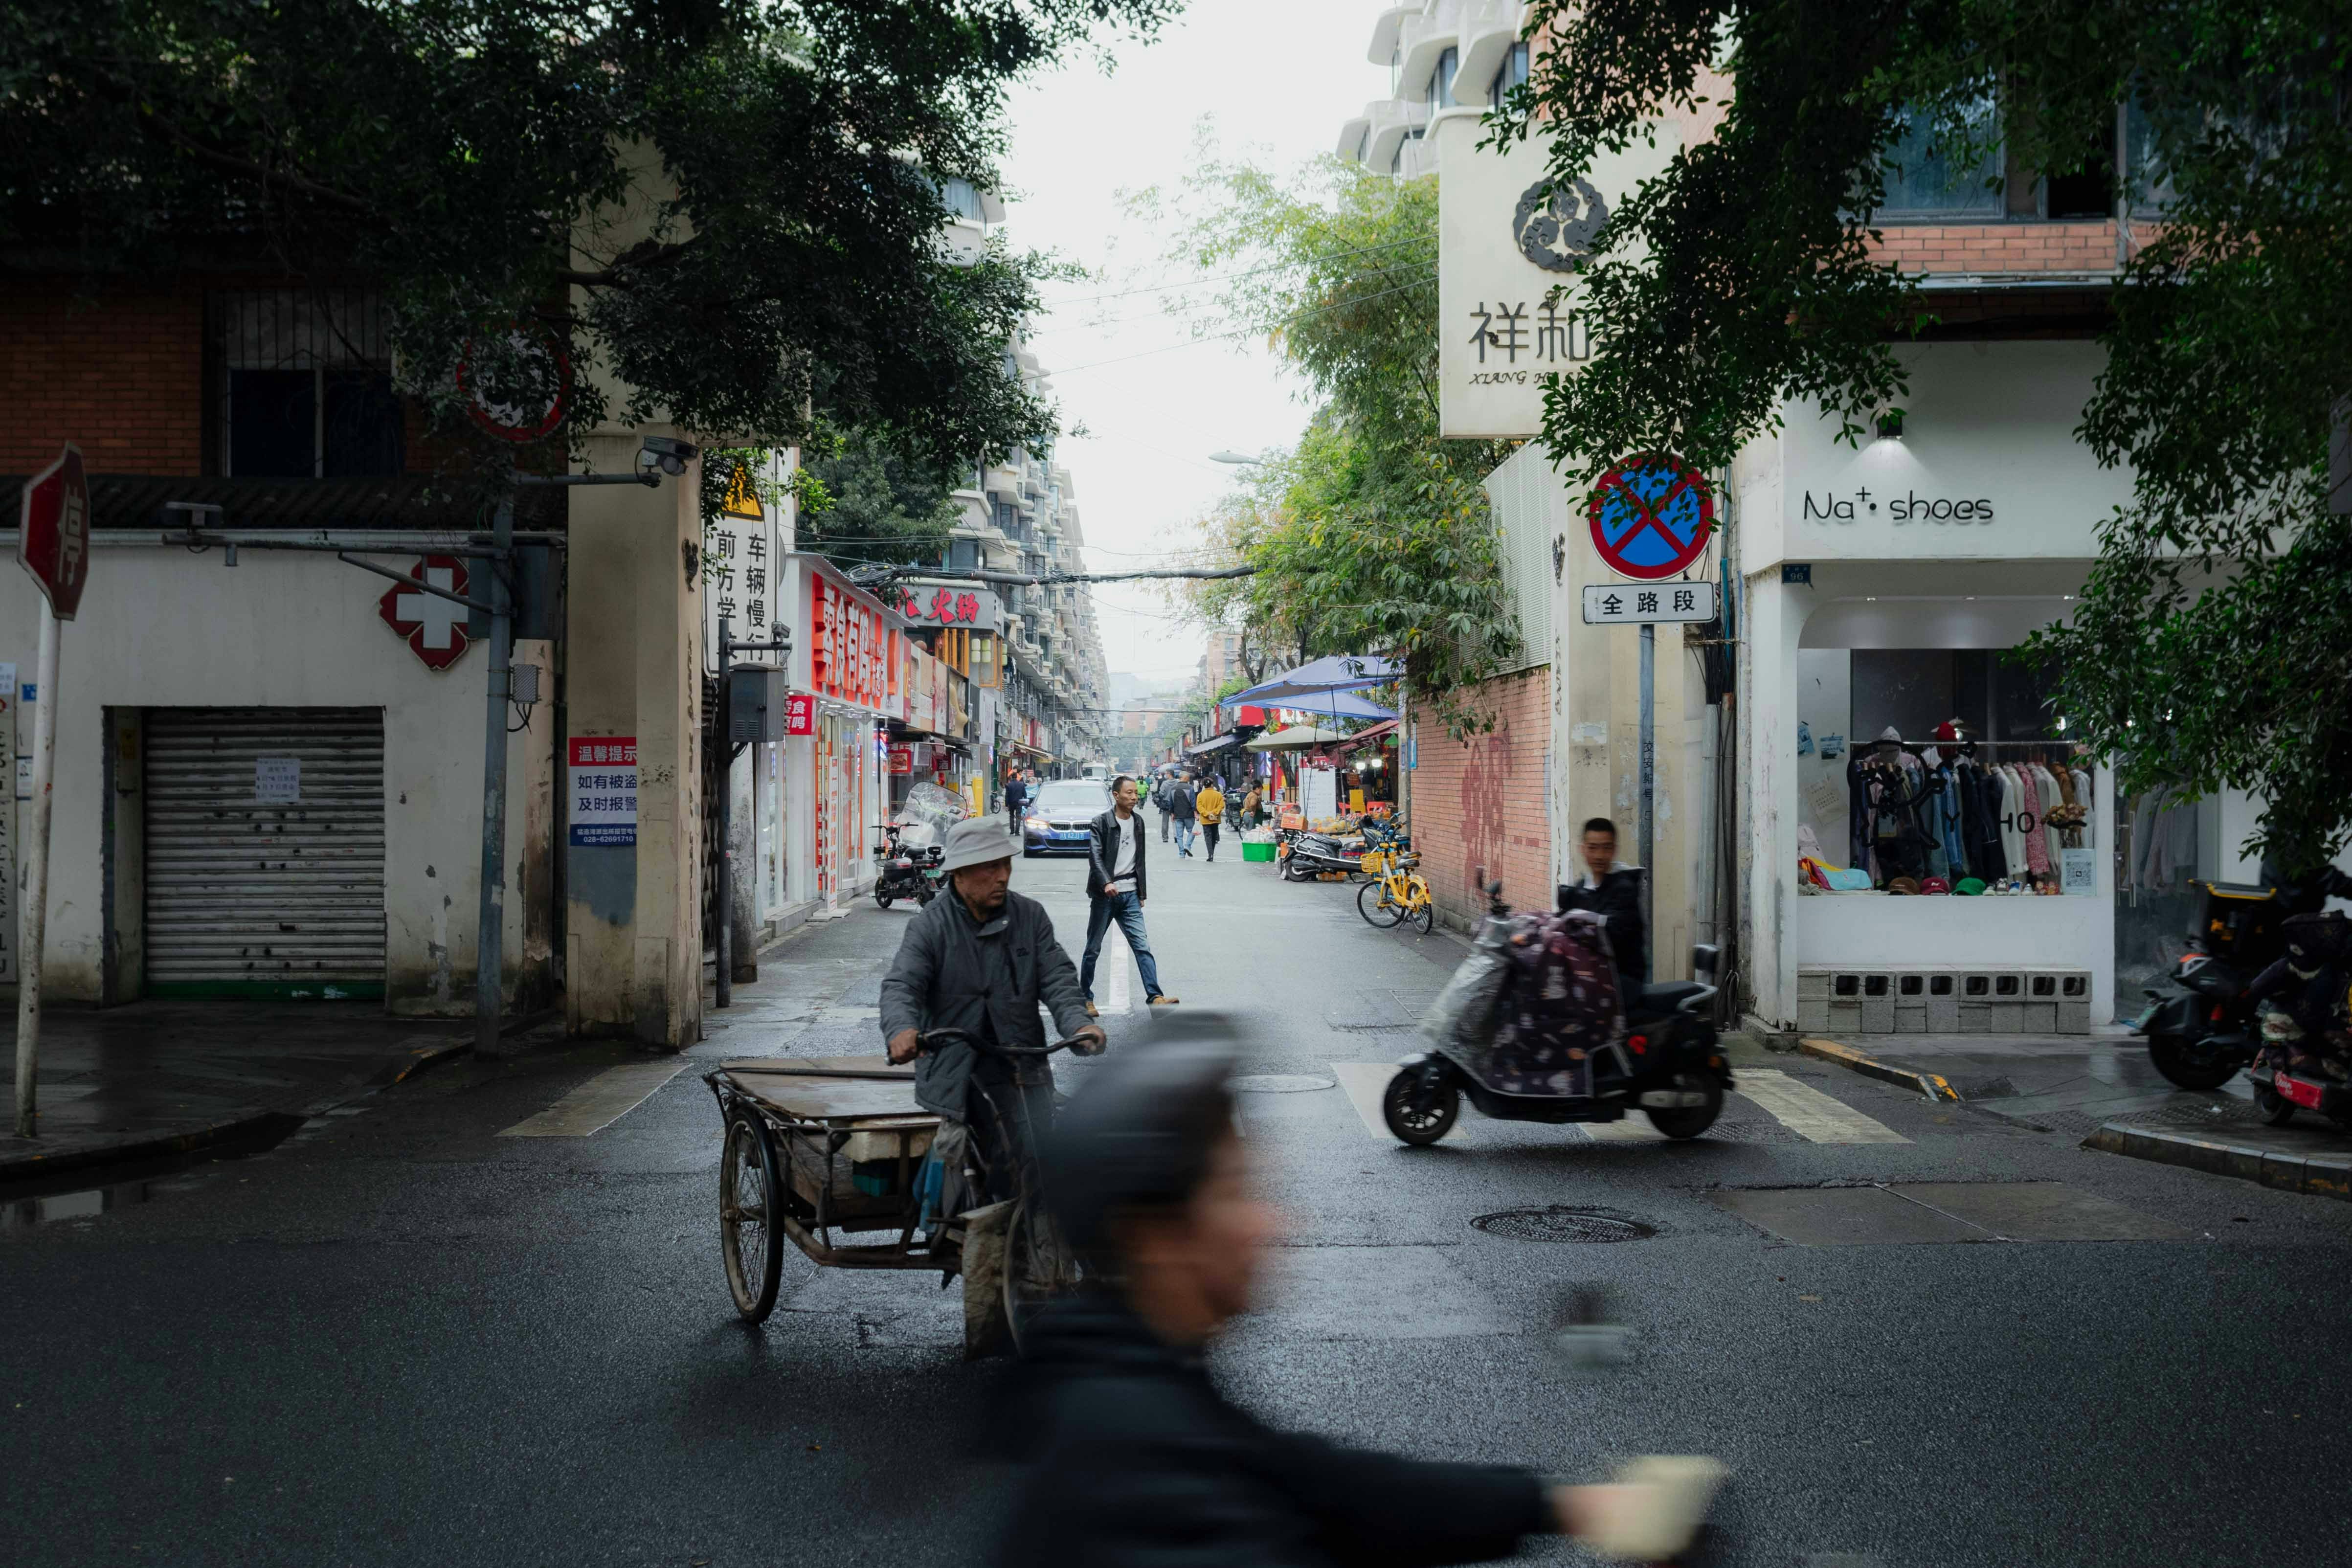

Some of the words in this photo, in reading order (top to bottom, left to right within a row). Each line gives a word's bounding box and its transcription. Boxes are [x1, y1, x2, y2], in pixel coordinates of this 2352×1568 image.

[1469, 370, 1526, 384] XIANG
[1534, 372, 1559, 384] H
[1889, 490, 1994, 520] shoes
[746, 534, 766, 661] 车辆慢行
[1602, 590, 1695, 615] 全路段
[579, 745, 637, 762] 温馨提示
[578, 775, 637, 789] 如有被盗
[579, 796, 637, 811] 及时报警
